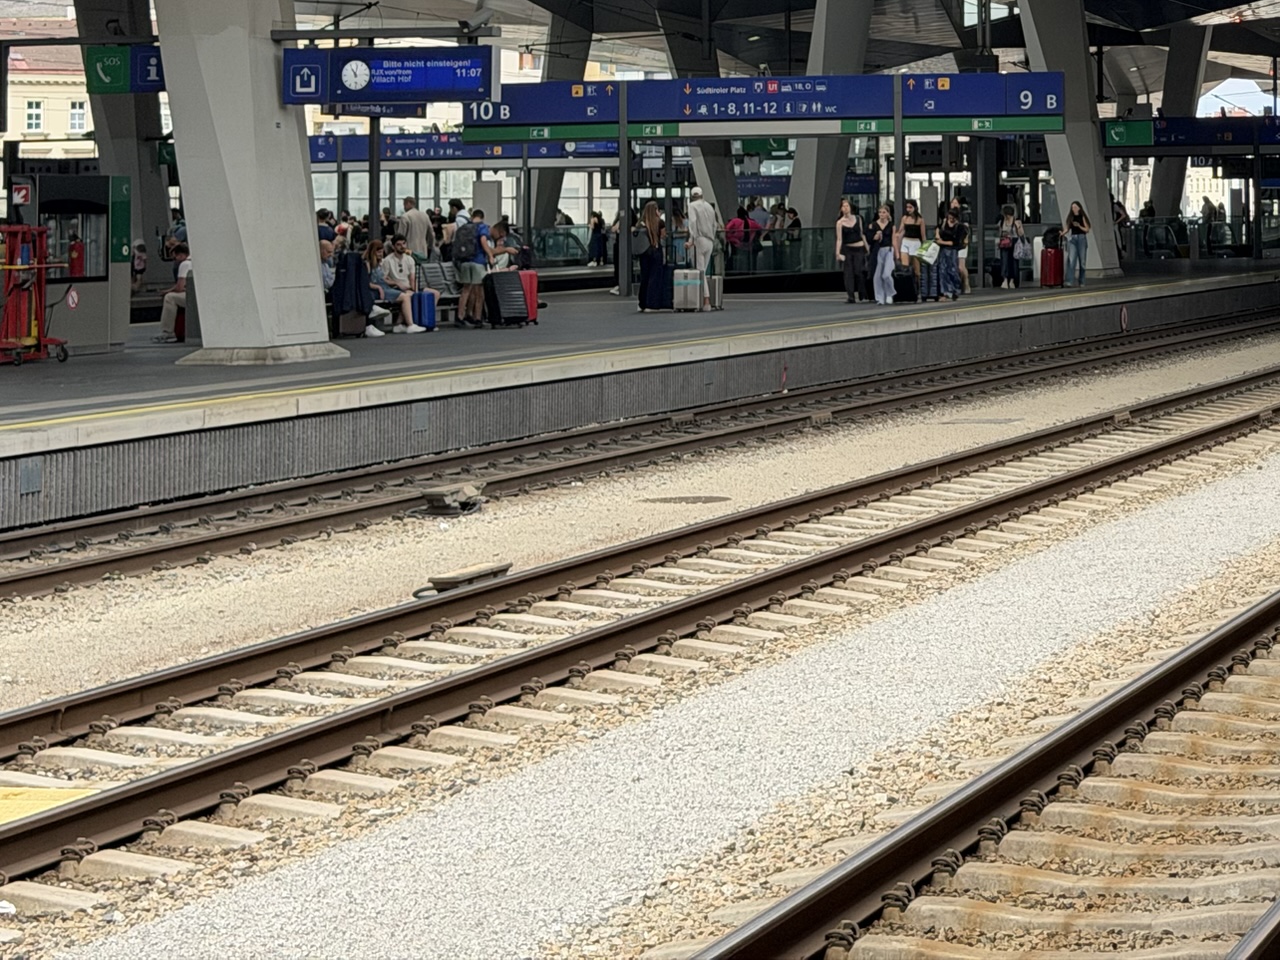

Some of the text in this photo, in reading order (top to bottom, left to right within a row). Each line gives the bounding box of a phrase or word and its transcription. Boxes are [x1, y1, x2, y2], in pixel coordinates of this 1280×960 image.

[103, 57, 120, 65] SOS
[455, 68, 482, 77] 11:07
[1019, 90, 1057, 110] 9 B
[469, 102, 510, 120] 10 B
